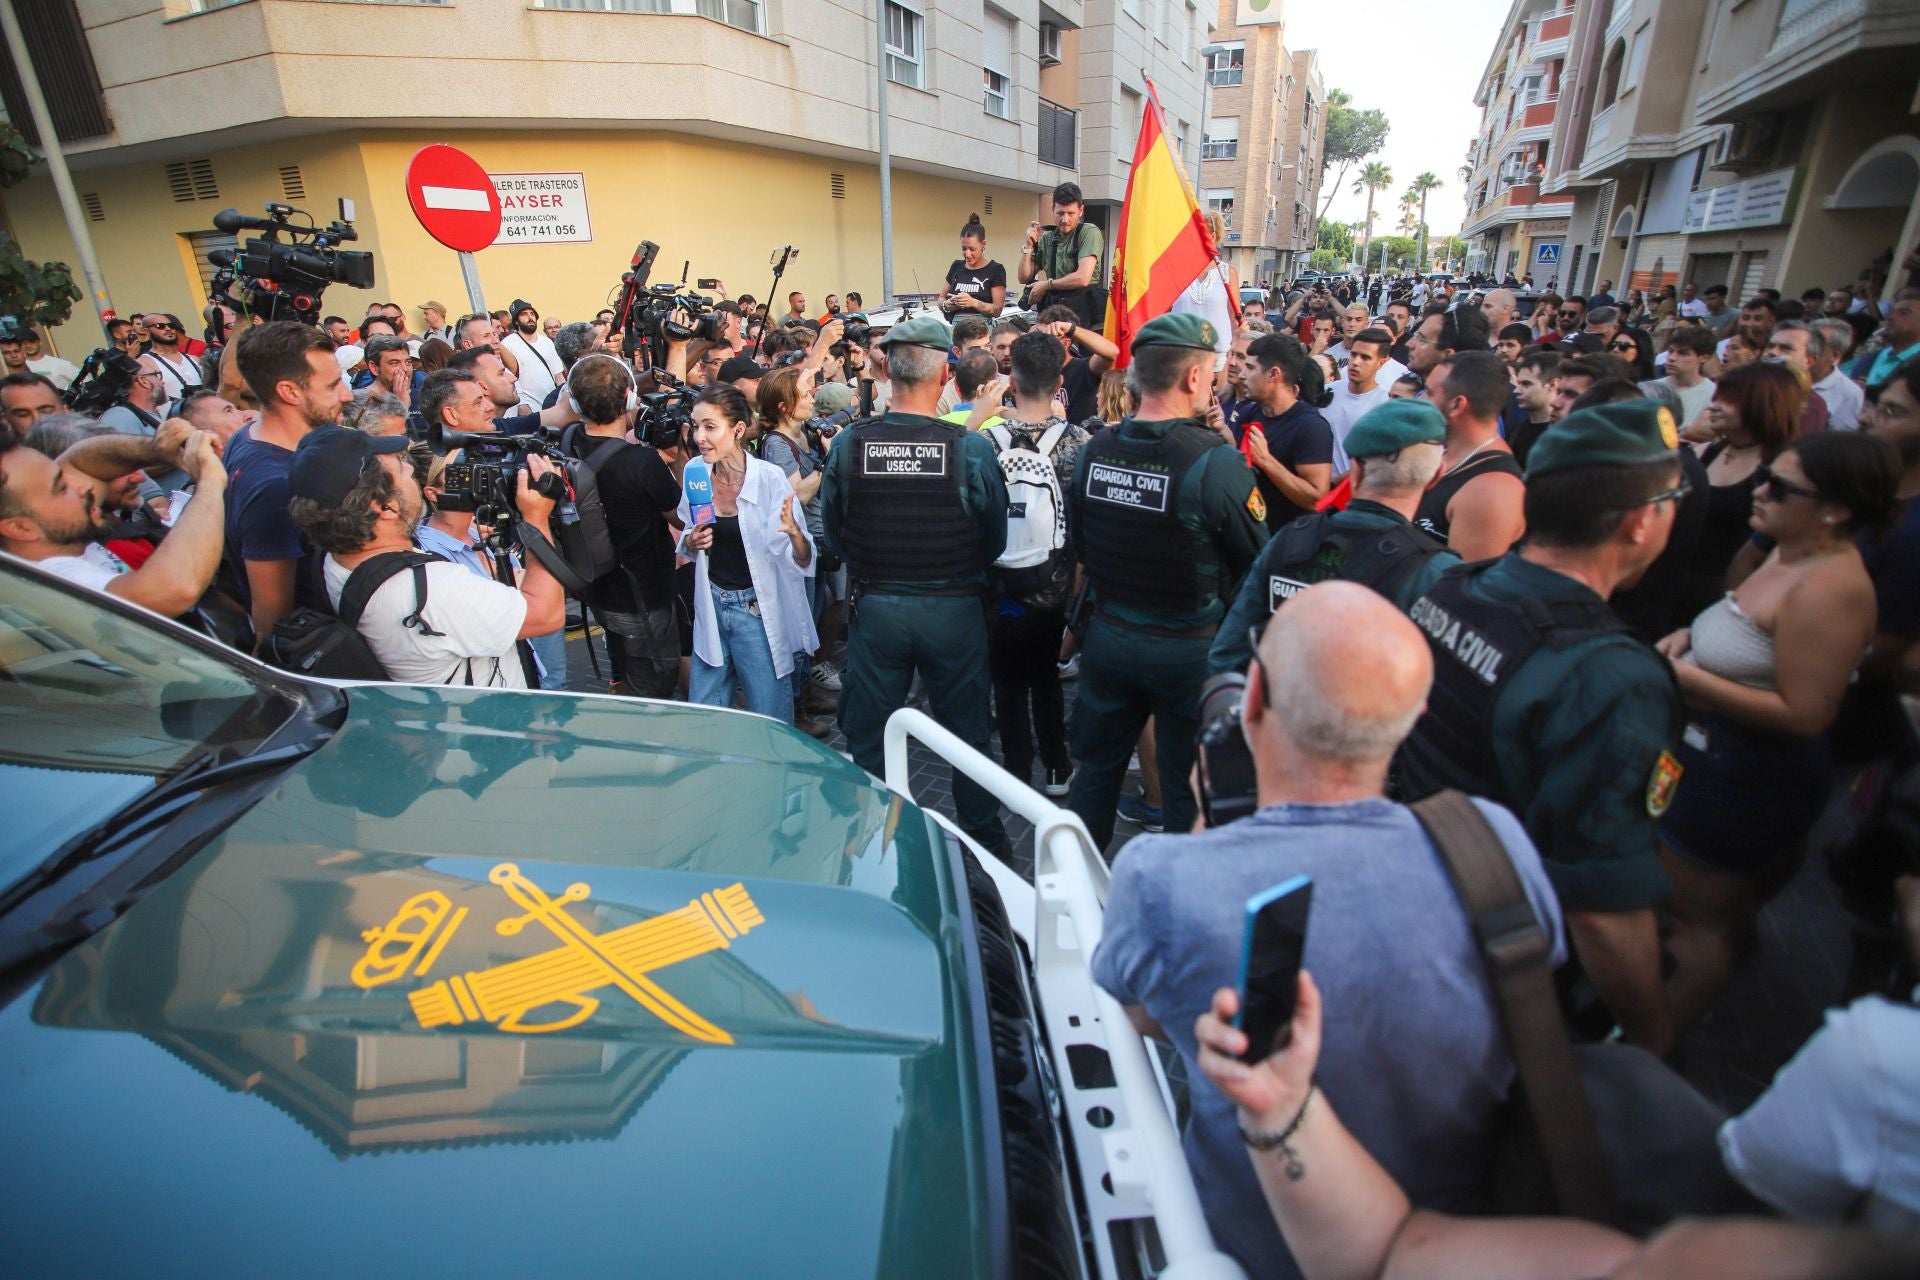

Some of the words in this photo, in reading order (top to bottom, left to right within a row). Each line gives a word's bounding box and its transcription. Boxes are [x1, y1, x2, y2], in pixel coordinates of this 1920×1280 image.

[493, 181, 513, 191] ILER
[514, 180, 527, 191] DE
[529, 179, 579, 191] TRASTEROS
[500, 194, 563, 209] AYSER
[507, 226, 527, 237] 641
[531, 225, 551, 236] 741
[555, 224, 576, 235] 056
[954, 282, 980, 293] PUMA
[868, 445, 912, 458] GUARDIA
[915, 446, 941, 458] CIVIL
[886, 460, 922, 472] USECIC
[688, 480, 708, 491] tve
[1093, 467, 1133, 487] GUARDIA
[1136, 475, 1162, 492] CIVIL
[1106, 486, 1142, 504] USECIC
[1273, 581, 1305, 599] GUA
[1457, 630, 1503, 683] CIVIL
